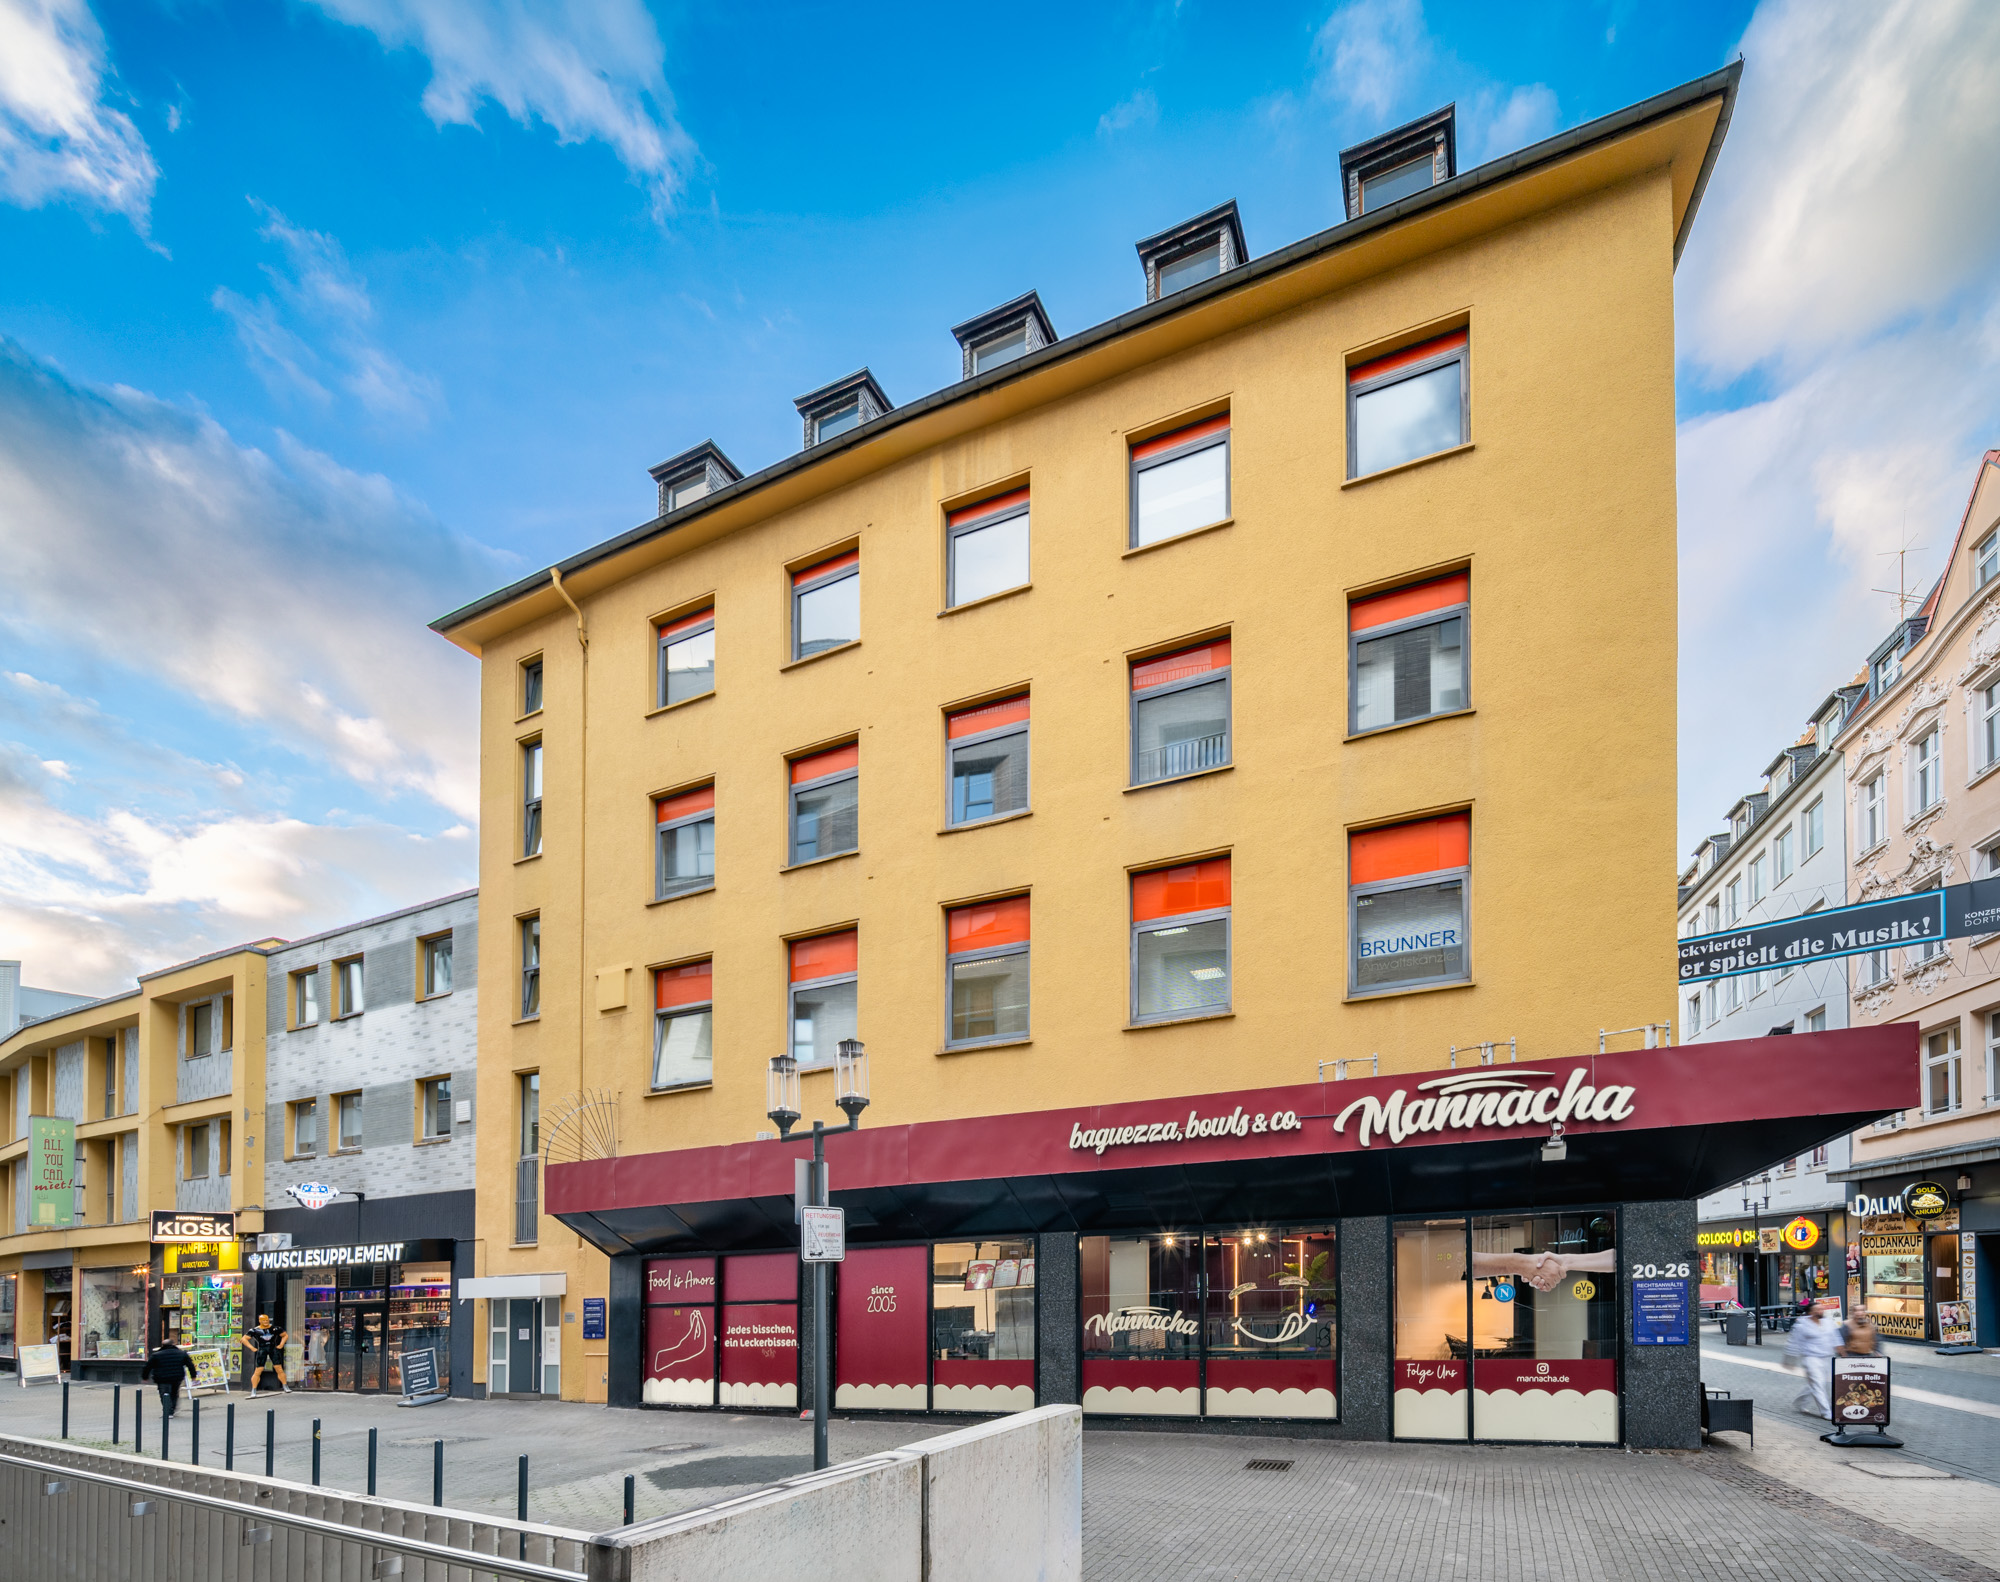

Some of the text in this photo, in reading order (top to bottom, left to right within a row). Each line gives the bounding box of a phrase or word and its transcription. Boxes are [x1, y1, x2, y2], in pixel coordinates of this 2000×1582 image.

[1360, 929, 1456, 957] BRUNNER
[1679, 916, 1931, 977] er spielt die Musik!
[1361, 950, 1459, 972] Anwaltskanzlei
[1333, 1067, 1636, 1147] Mannacha
[1069, 1106, 1302, 1155] baguezza, bowls & co.
[43, 1139, 64, 1151] ALL
[44, 1154, 63, 1166] YOU
[43, 1169, 63, 1180] CAN
[34, 1179, 73, 1191] miet!
[1916, 1186, 1936, 1194] GOLD
[1850, 1193, 1904, 1216] DALM
[1915, 1207, 1943, 1215] ANKAUF
[157, 1221, 231, 1236] KIOSK
[1711, 1232, 1733, 1245] LOCO
[1863, 1235, 1923, 1249] GOLDANKAUF
[177, 1242, 219, 1255] FANFIESTA
[262, 1243, 404, 1269] MUSCLESUPPLEMENT
[1632, 1263, 1690, 1279] 20-26
[648, 1269, 715, 1291] Food is Amore
[871, 1285, 894, 1295] since
[1575, 1282, 1593, 1295] BVB
[867, 1295, 897, 1312] 2005
[726, 1324, 795, 1335] Jedes bisschen,
[1084, 1310, 1199, 1336] Mannacha
[1943, 1325, 1969, 1335] GOLD
[724, 1338, 739, 1348] ein
[1407, 1363, 1457, 1384] Folge Uns
[1516, 1375, 1570, 1383] mannacha.de
